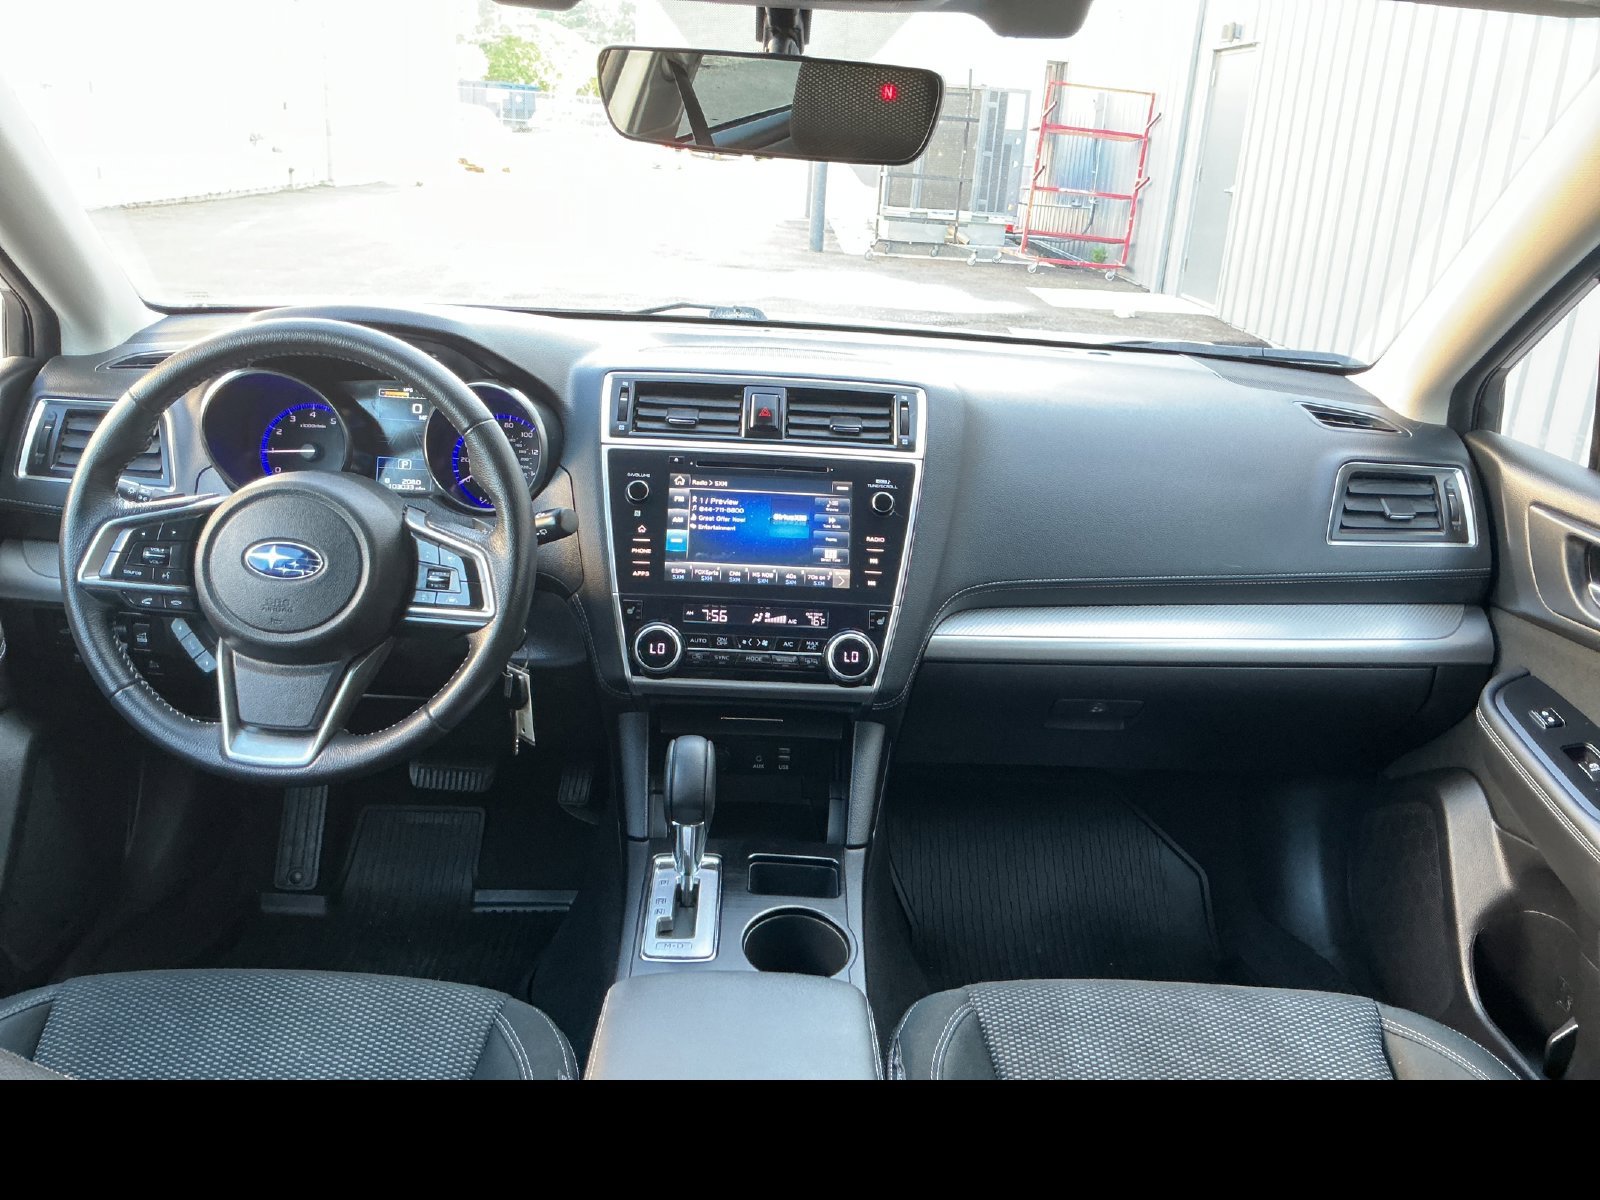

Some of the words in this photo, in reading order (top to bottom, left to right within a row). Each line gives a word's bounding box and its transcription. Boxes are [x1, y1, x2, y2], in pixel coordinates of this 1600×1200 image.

[884, 85, 893, 99] N
[412, 404, 422, 414] 0
[710, 498, 738, 506] Preview
[702, 609, 728, 622] 7:56
[650, 643, 666, 654] LO
[844, 652, 859, 662] LO
